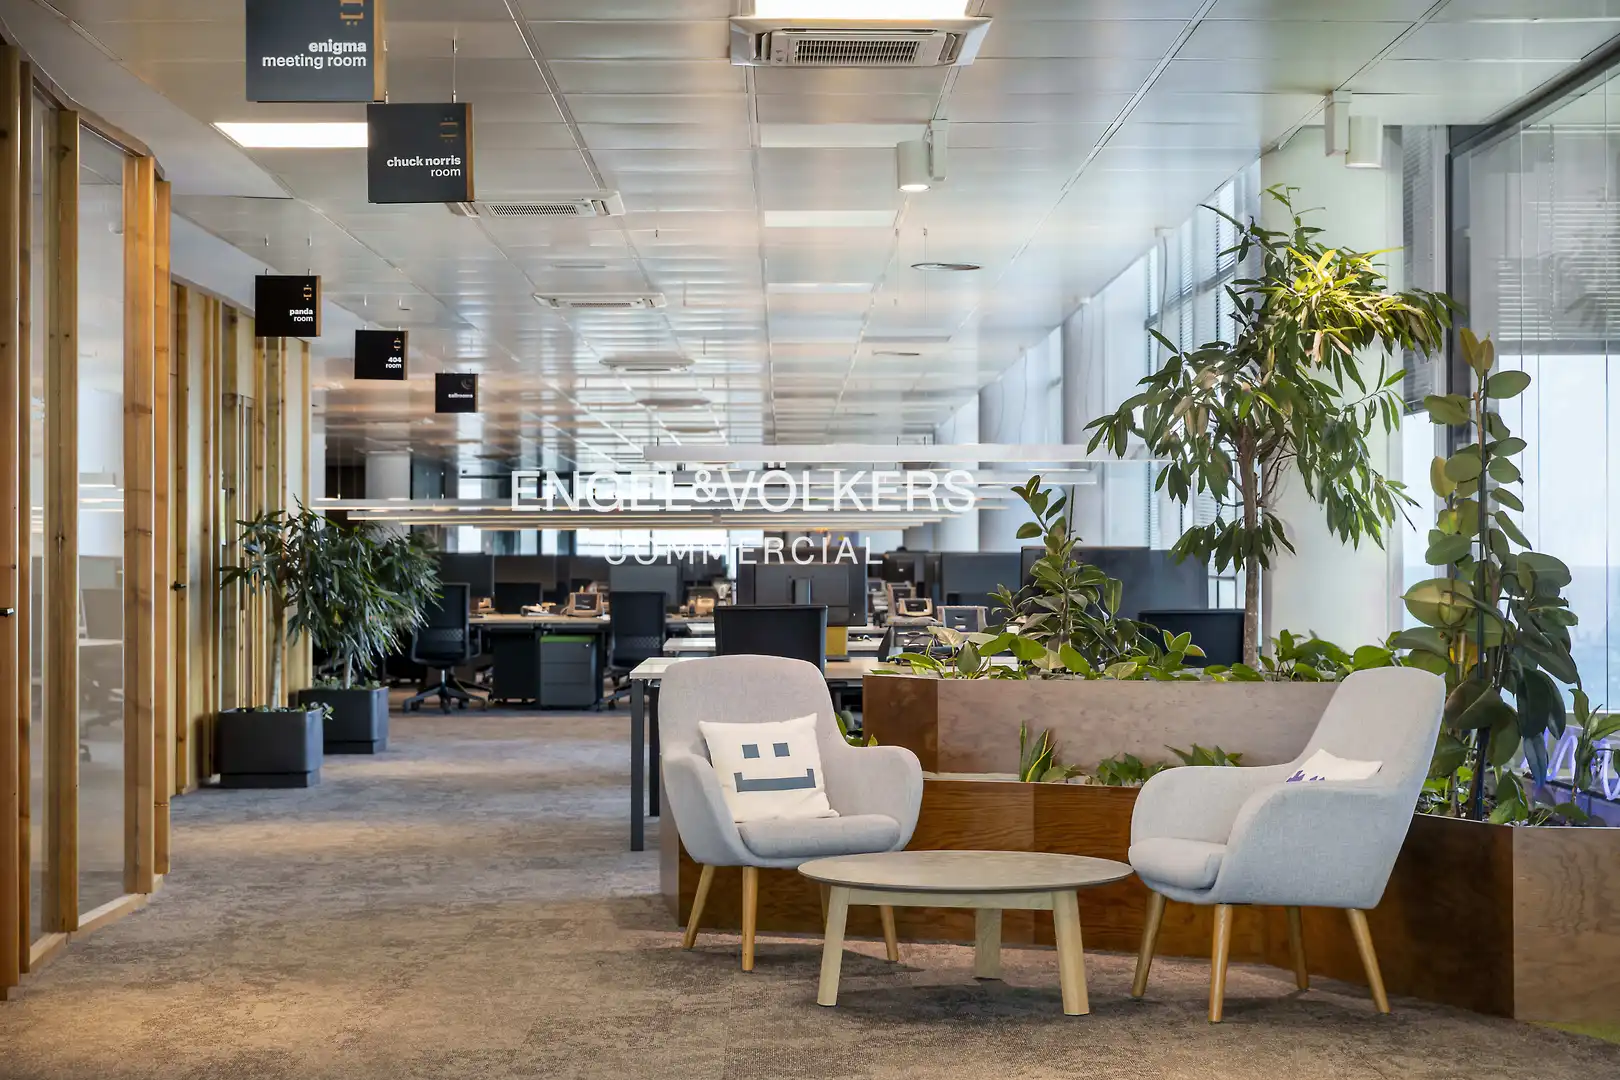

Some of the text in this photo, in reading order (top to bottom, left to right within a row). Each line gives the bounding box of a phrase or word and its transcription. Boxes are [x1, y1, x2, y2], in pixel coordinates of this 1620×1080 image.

[308, 38, 367, 55] enigma
[262, 53, 367, 69] meeting room
[386, 154, 461, 167] chuck norris
[430, 168, 461, 177] room
[289, 307, 314, 317] panda
